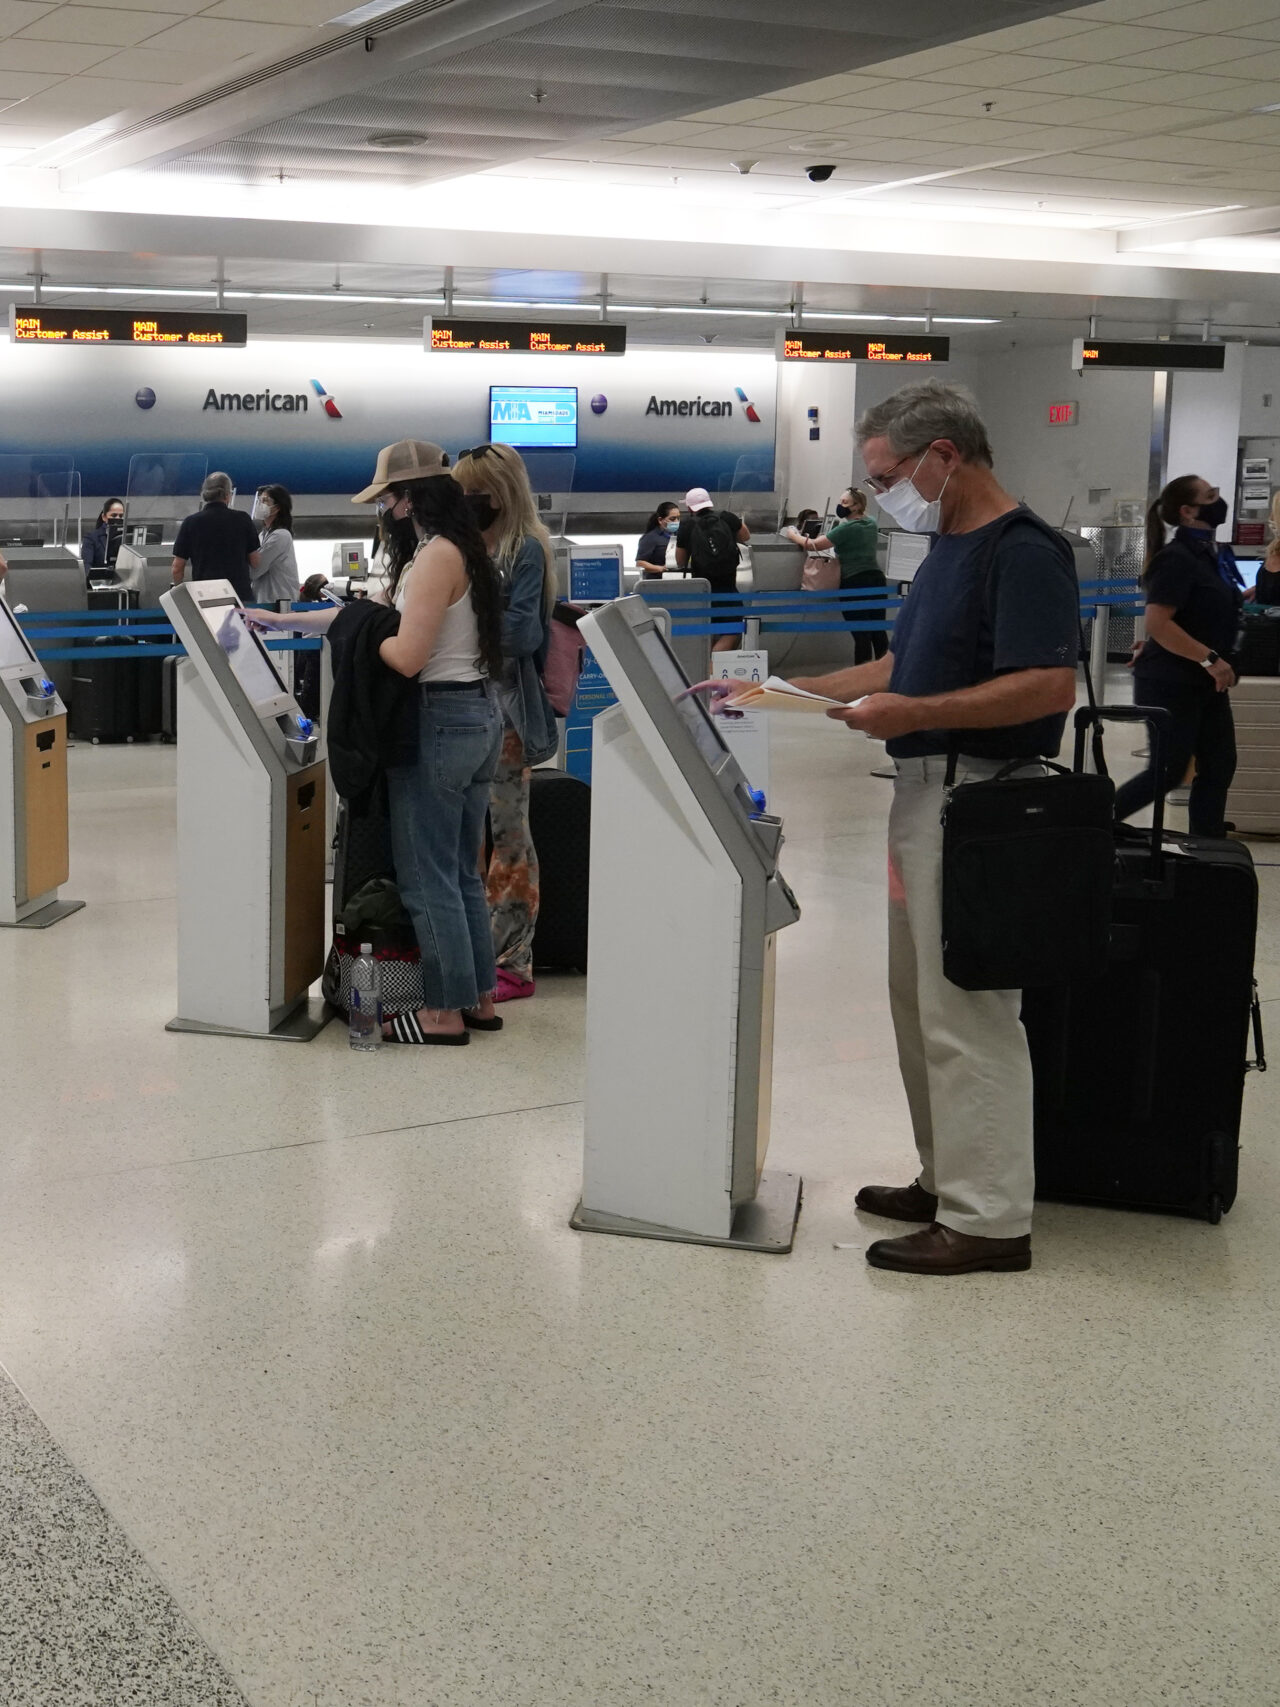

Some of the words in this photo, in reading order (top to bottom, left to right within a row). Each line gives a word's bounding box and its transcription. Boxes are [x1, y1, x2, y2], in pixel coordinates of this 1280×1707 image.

[15, 318, 40, 329] MAIN
[133, 321, 157, 332] MAIN
[15, 328, 68, 339] Customer
[72, 329, 110, 340] Assist
[133, 331, 184, 342] Customer
[187, 332, 223, 343] Assist
[431, 330, 453, 340] MAIN
[529, 332, 551, 342] MAIN
[431, 338, 475, 348] Customer
[479, 339, 511, 349] Assist
[529, 341, 572, 351] Customer
[574, 342, 606, 352] Assist
[784, 340, 803, 350] MAIN
[867, 343, 886, 353] MAIN
[784, 348, 822, 358] Customer
[824, 349, 852, 359] Assist
[867, 351, 904, 361] Customer
[906, 352, 932, 361] Assist
[1082, 350, 1099, 359] MAIN
[202, 388, 308, 412] American
[646, 395, 733, 417] American
[1049, 405, 1070, 423] EXIT
[579, 672, 607, 680] CARRY-O
